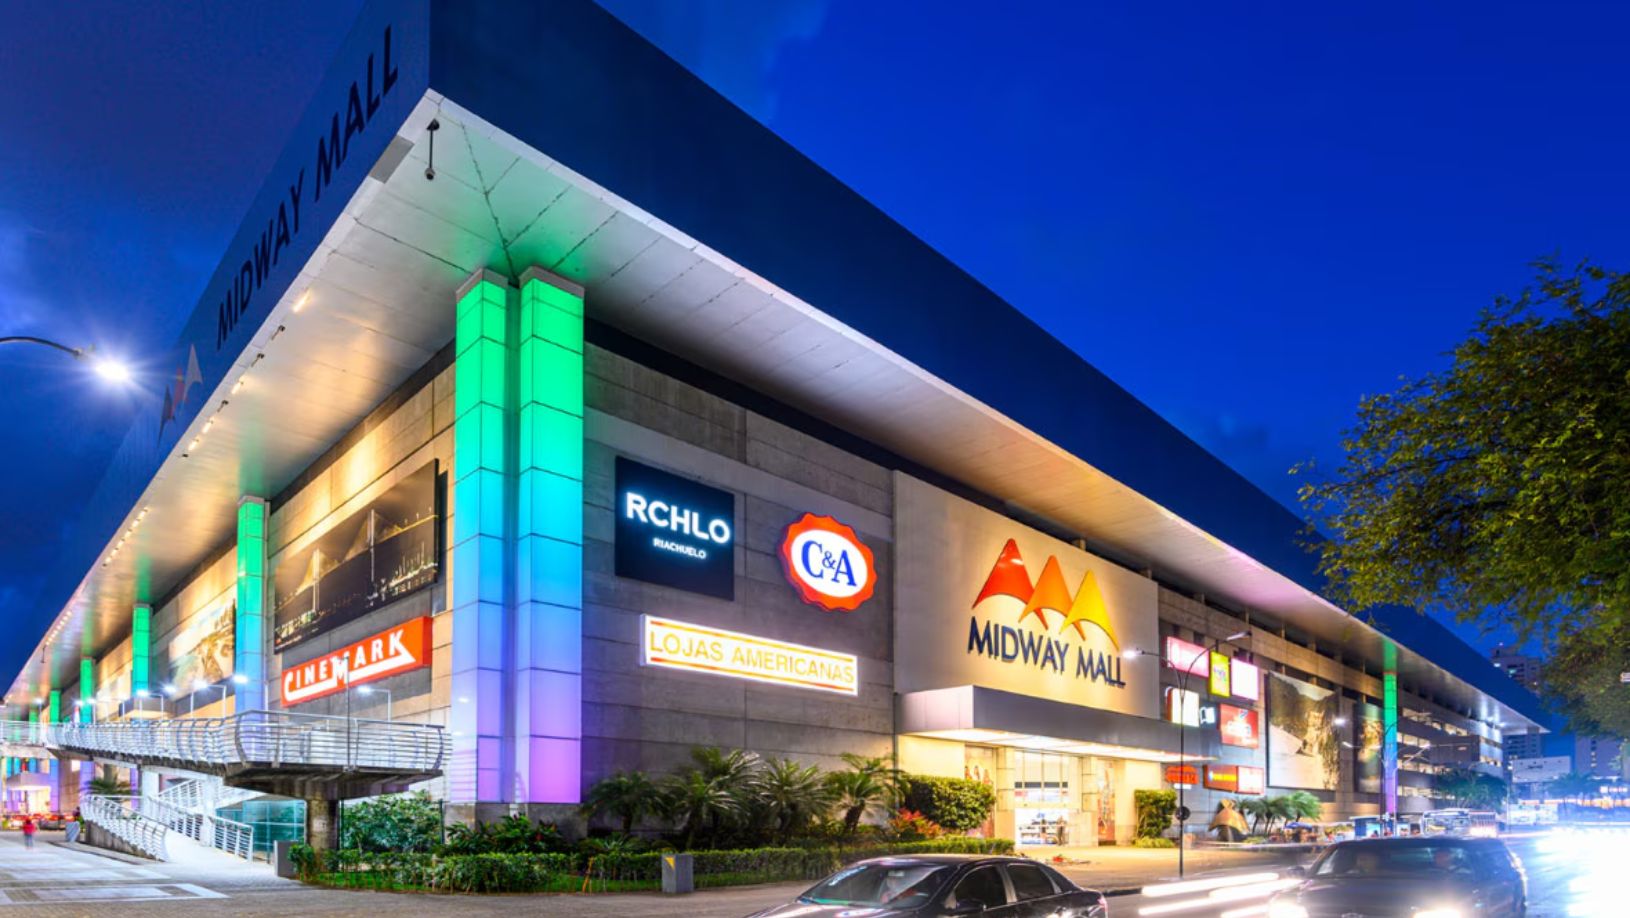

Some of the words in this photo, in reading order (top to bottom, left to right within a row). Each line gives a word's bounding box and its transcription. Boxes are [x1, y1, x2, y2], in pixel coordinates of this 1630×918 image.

[217, 168, 304, 351] MIDWAY
[314, 24, 398, 203] MALL
[626, 492, 731, 544] RCHLO
[653, 537, 707, 560] RIACHUELO
[801, 540, 857, 587] C&A
[284, 629, 416, 702] CINEMARK
[650, 631, 724, 662] LOJAS
[731, 646, 855, 684] AMERICANAS
[967, 616, 1069, 675] MIDWAY
[1076, 646, 1126, 688] MALL
